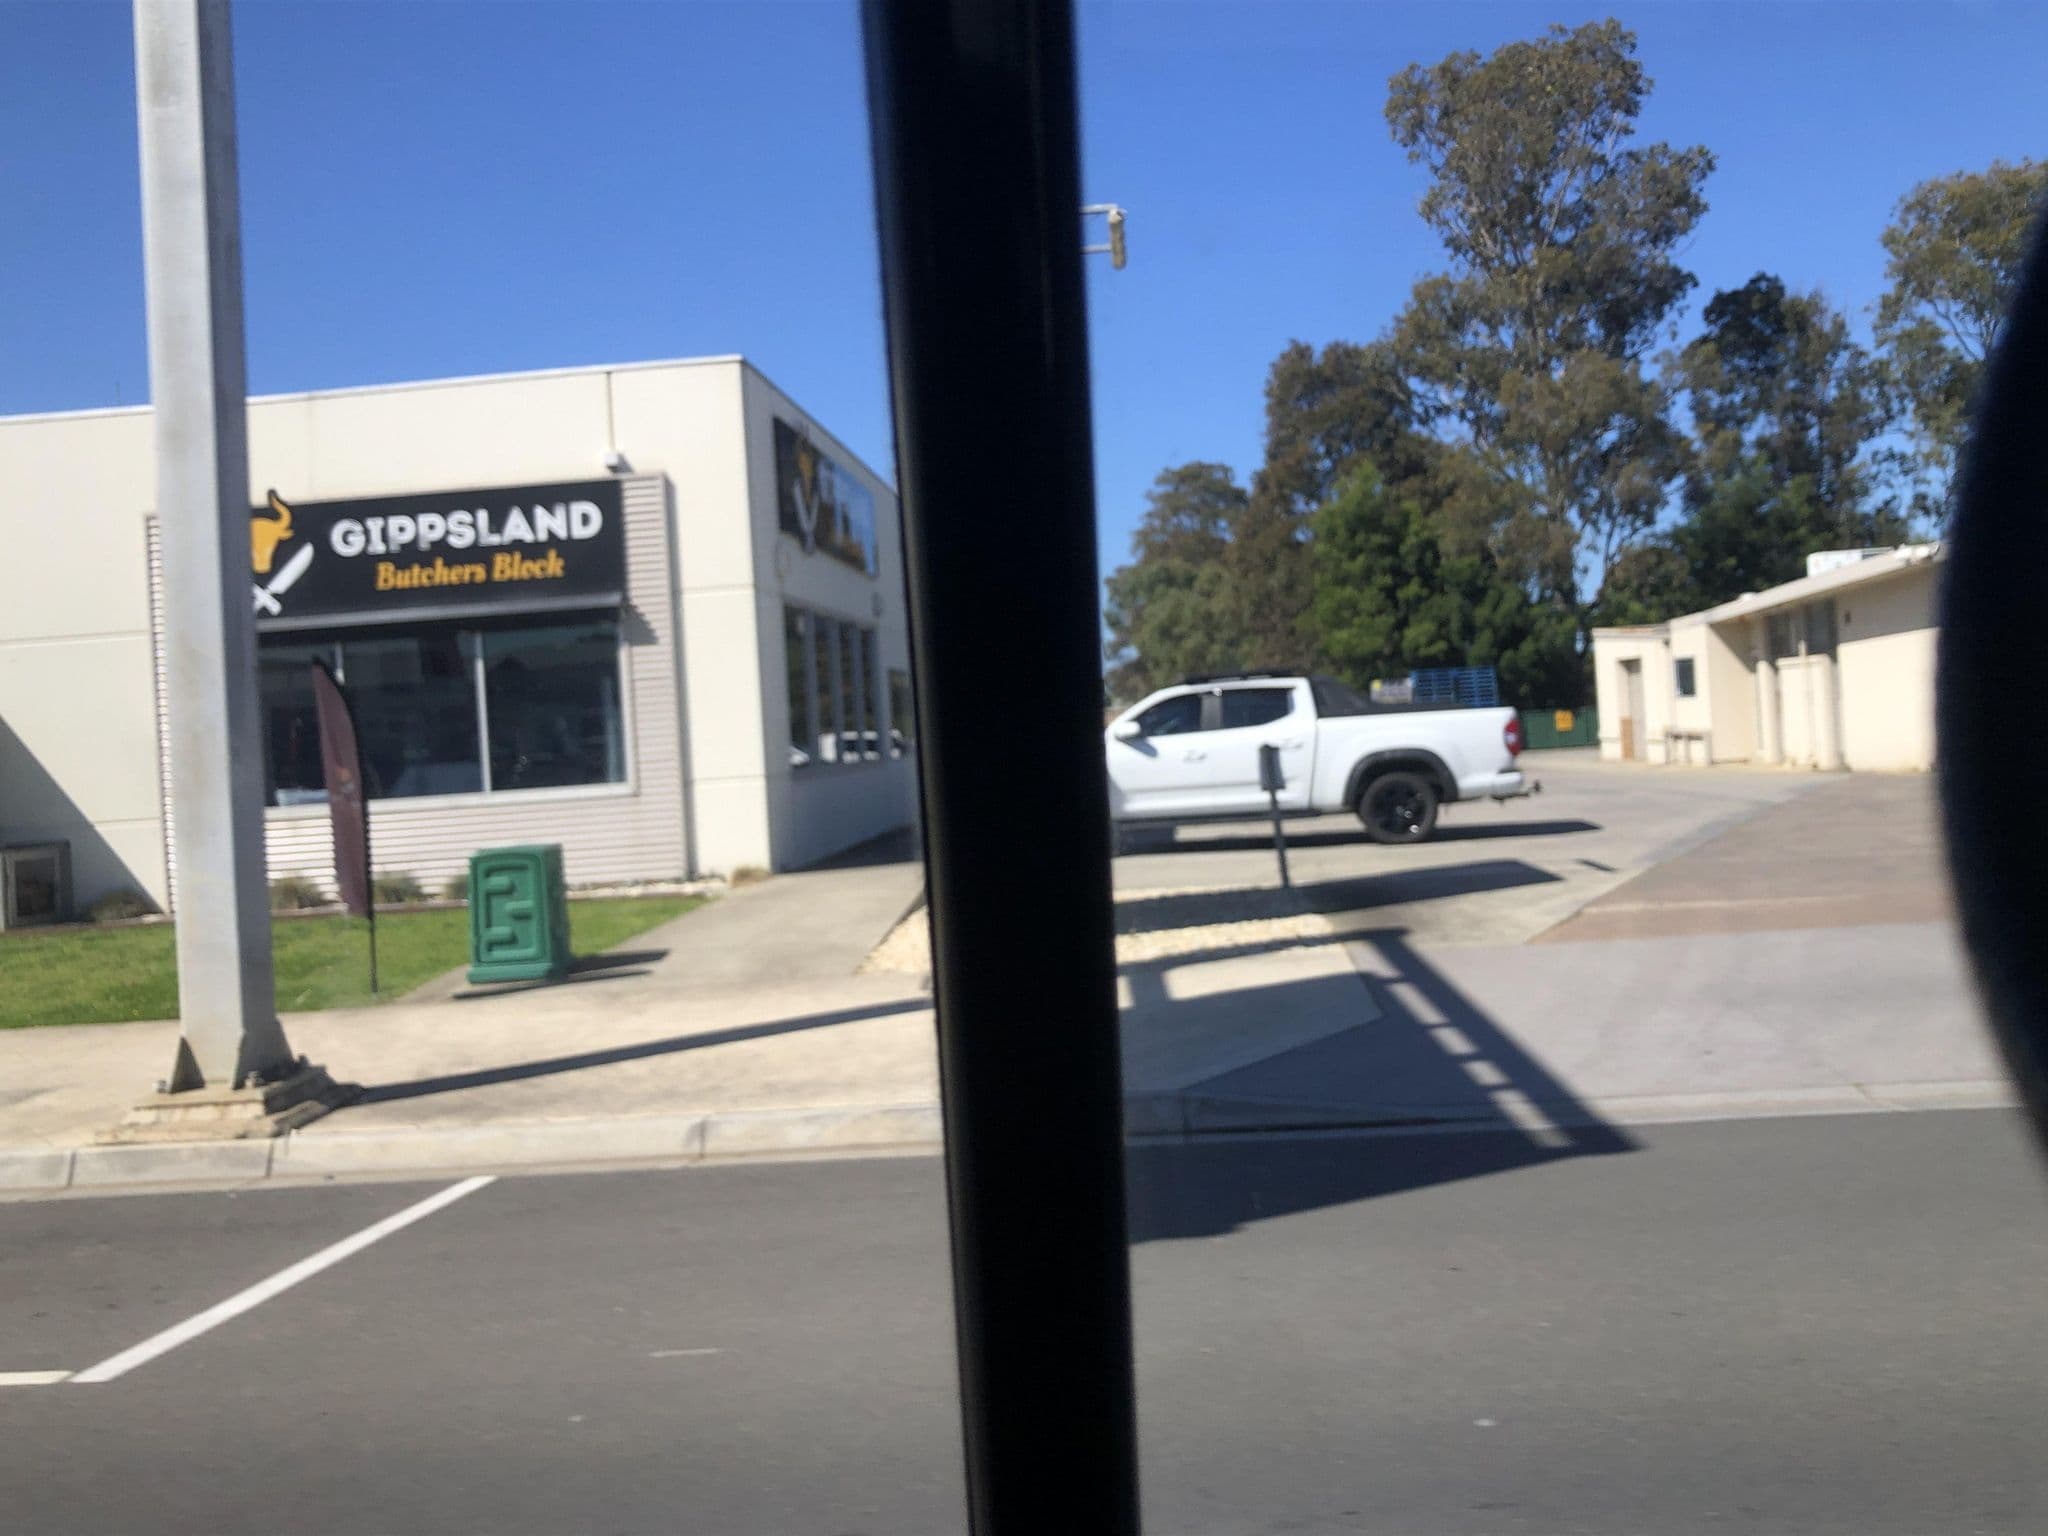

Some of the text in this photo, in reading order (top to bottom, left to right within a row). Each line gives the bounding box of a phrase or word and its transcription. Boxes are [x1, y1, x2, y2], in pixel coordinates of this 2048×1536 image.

[331, 501, 603, 557] GIPPSLAND
[375, 548, 565, 591] Butchers Block
